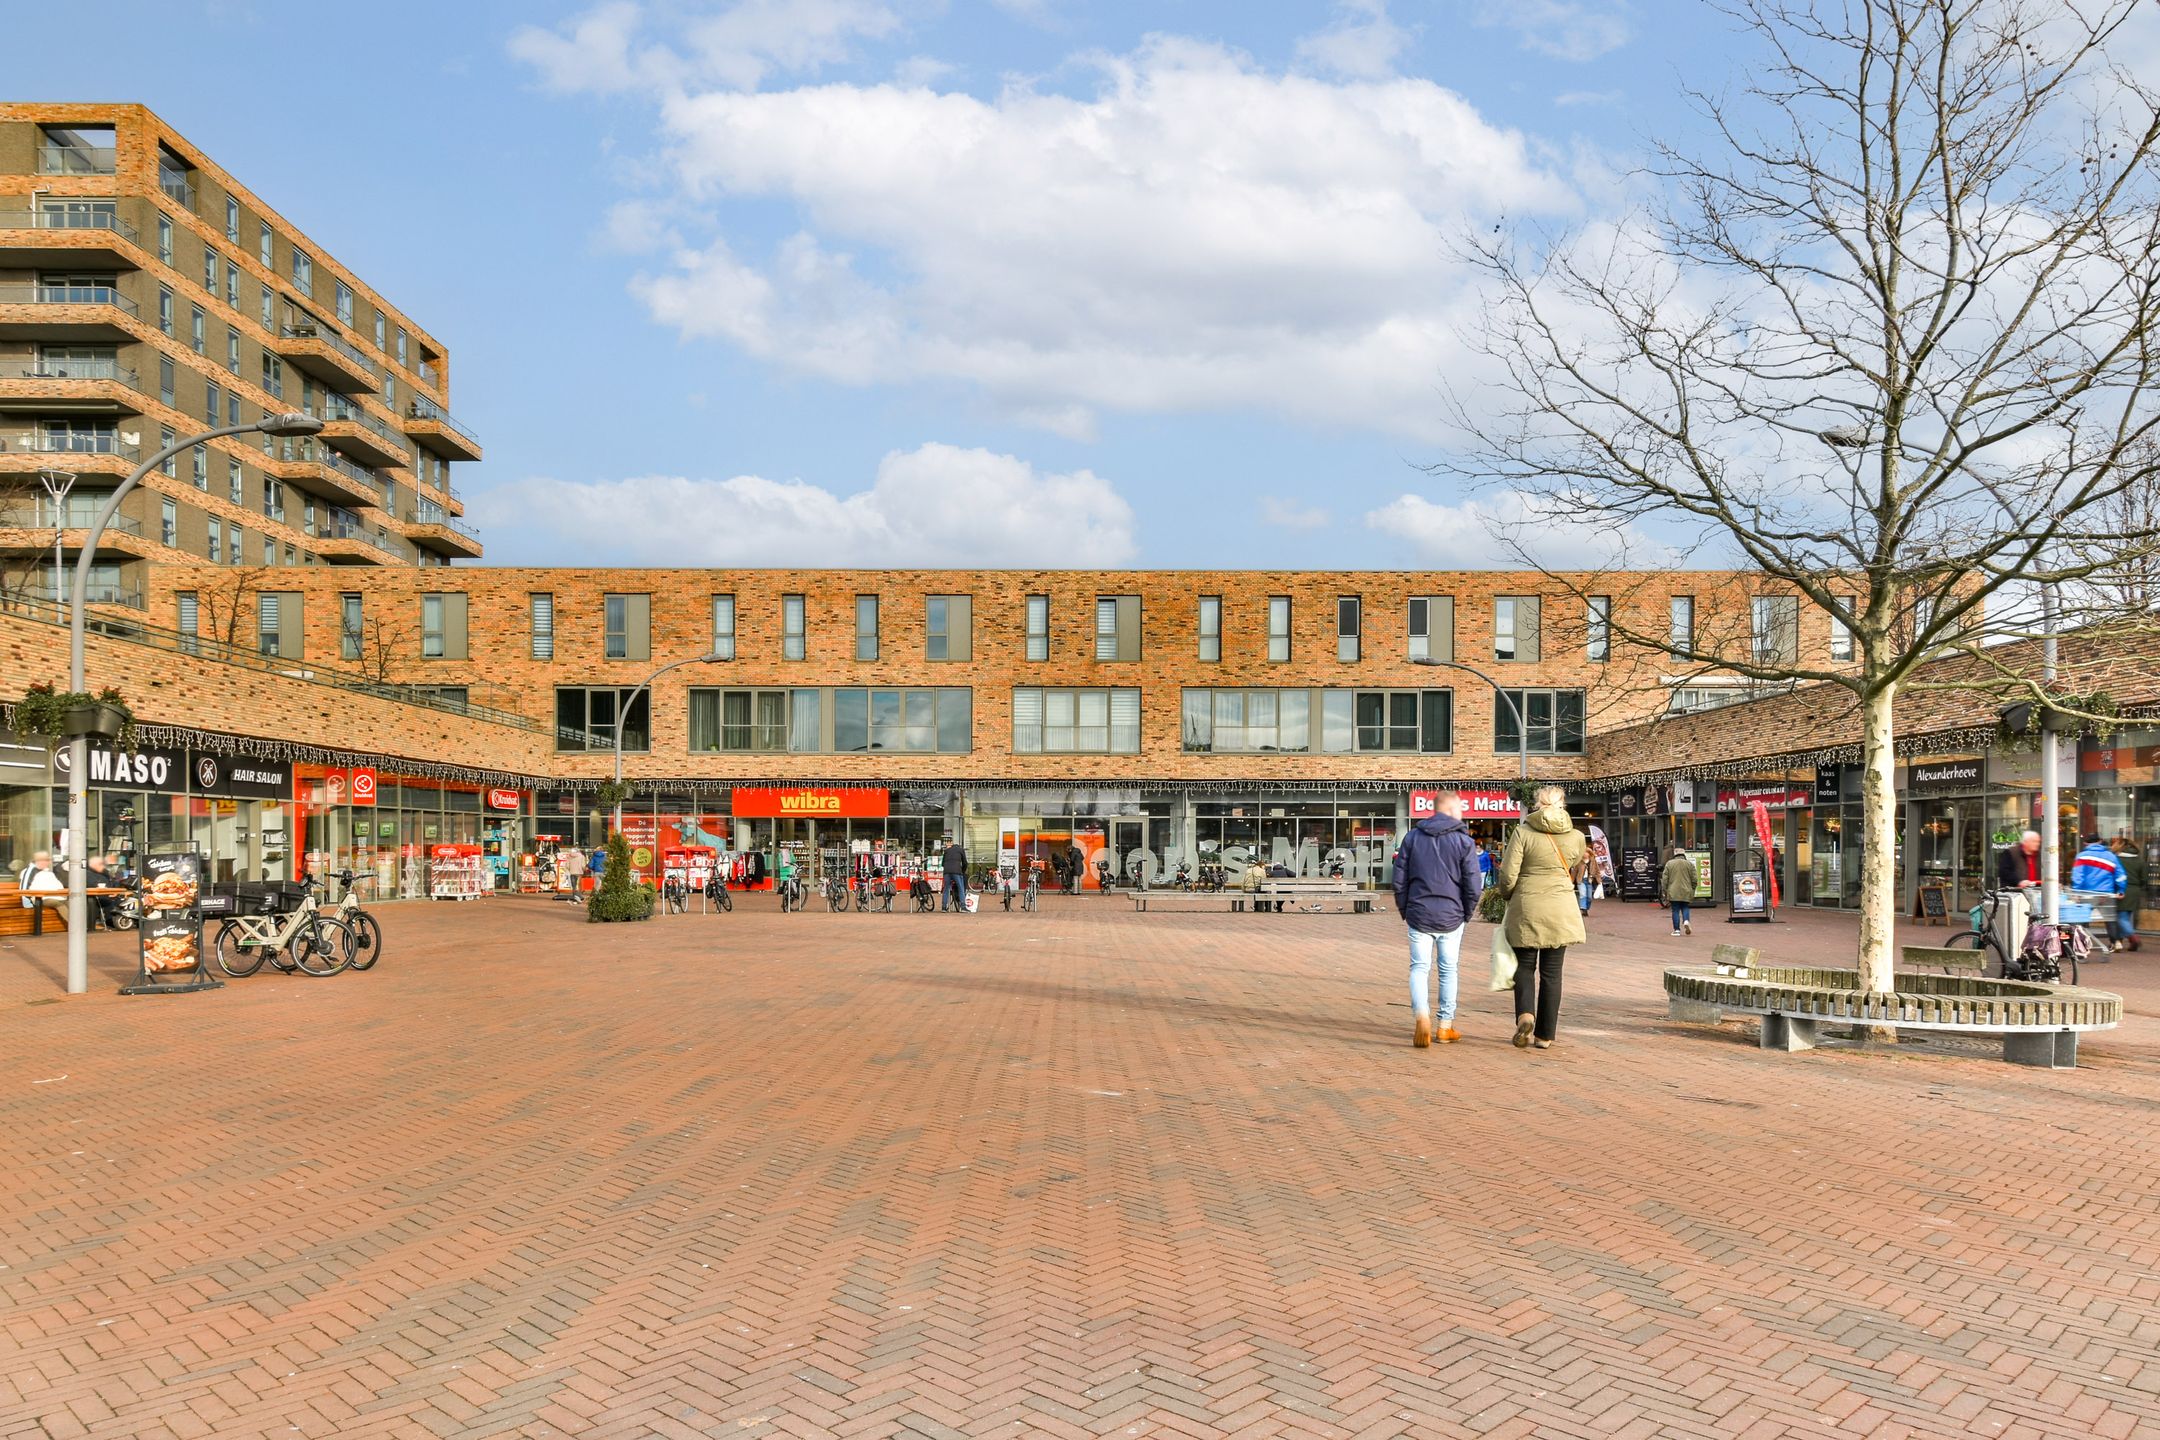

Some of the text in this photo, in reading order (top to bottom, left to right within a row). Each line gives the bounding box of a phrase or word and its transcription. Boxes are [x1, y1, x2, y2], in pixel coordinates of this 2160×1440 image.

[233, 769, 283, 785] HAIR SALON
[1916, 765, 1977, 781] Alexanderhoeve
[1825, 779, 1831, 787] &
[780, 791, 841, 809] wibra
[1415, 796, 1470, 812] Bos
